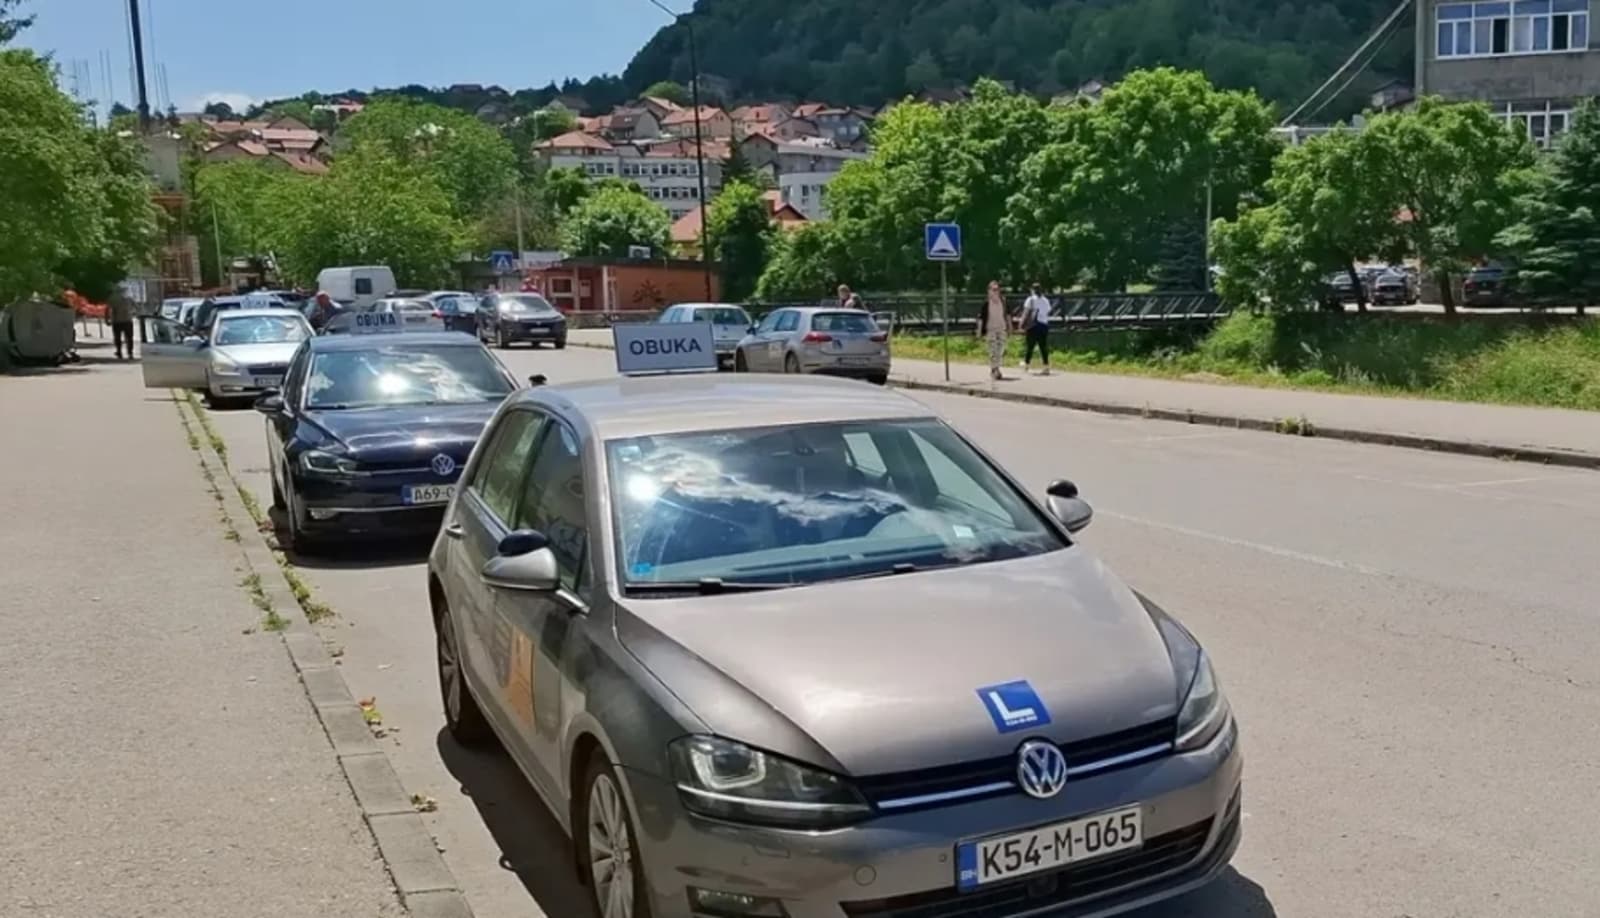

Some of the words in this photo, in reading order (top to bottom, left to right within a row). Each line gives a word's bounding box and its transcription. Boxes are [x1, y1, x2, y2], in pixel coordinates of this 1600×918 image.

[356, 313, 396, 326] OBUKA
[629, 338, 702, 355] OBUKA
[988, 691, 1035, 720] L
[983, 812, 1137, 877] K54-M-065
